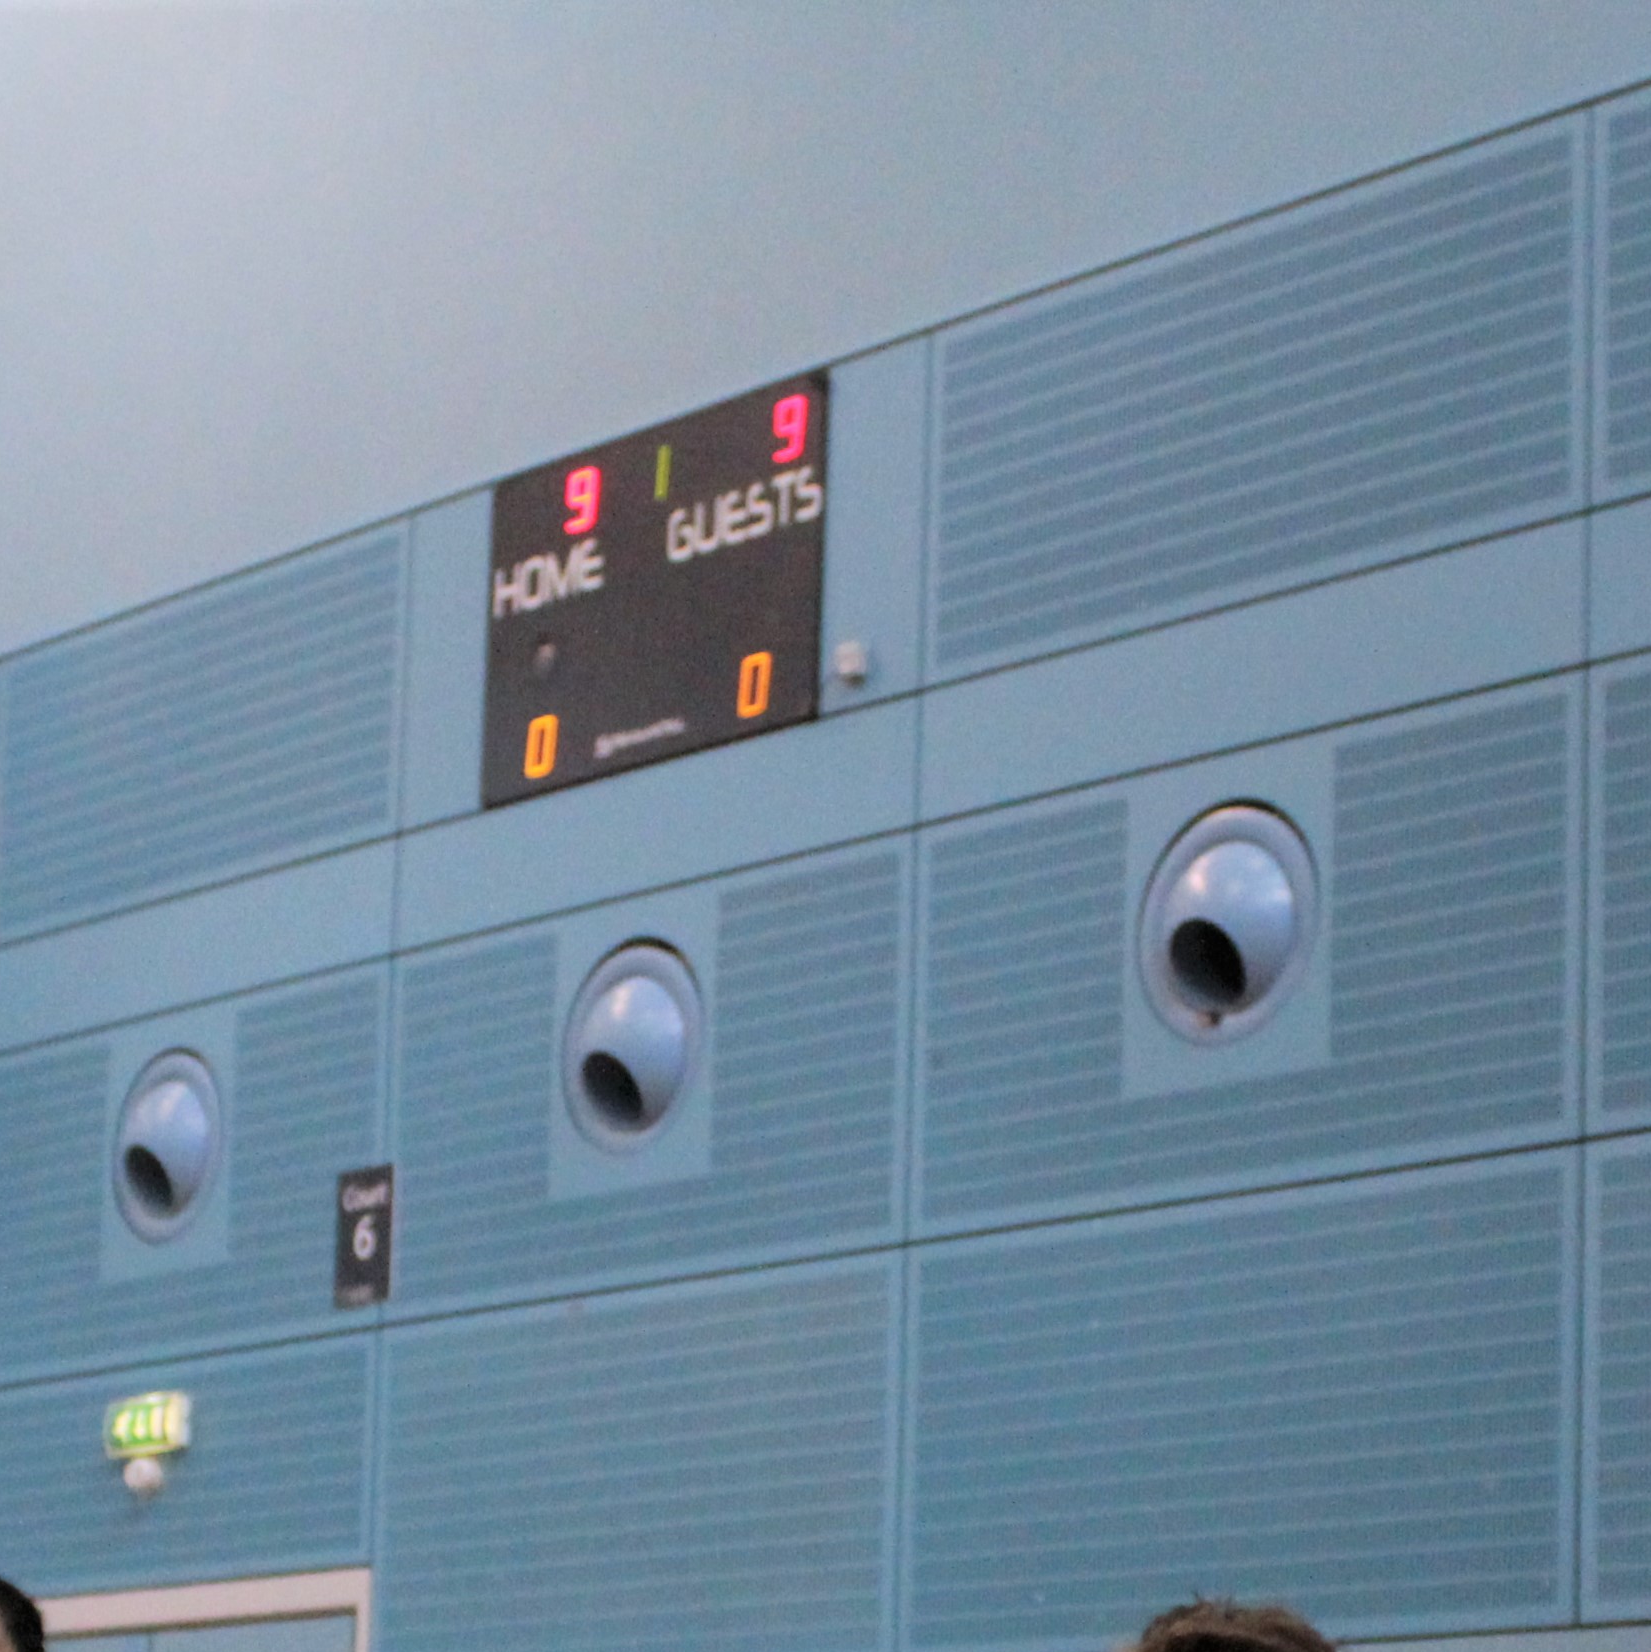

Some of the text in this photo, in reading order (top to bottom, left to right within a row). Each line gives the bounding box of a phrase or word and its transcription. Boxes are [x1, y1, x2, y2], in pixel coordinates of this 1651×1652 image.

[563, 466, 601, 534] 9
[772, 394, 808, 463] 9
[493, 467, 823, 618] HOME GUESTS
[524, 715, 558, 778] 0
[737, 652, 773, 718] 0
[353, 1214, 378, 1261] 6
